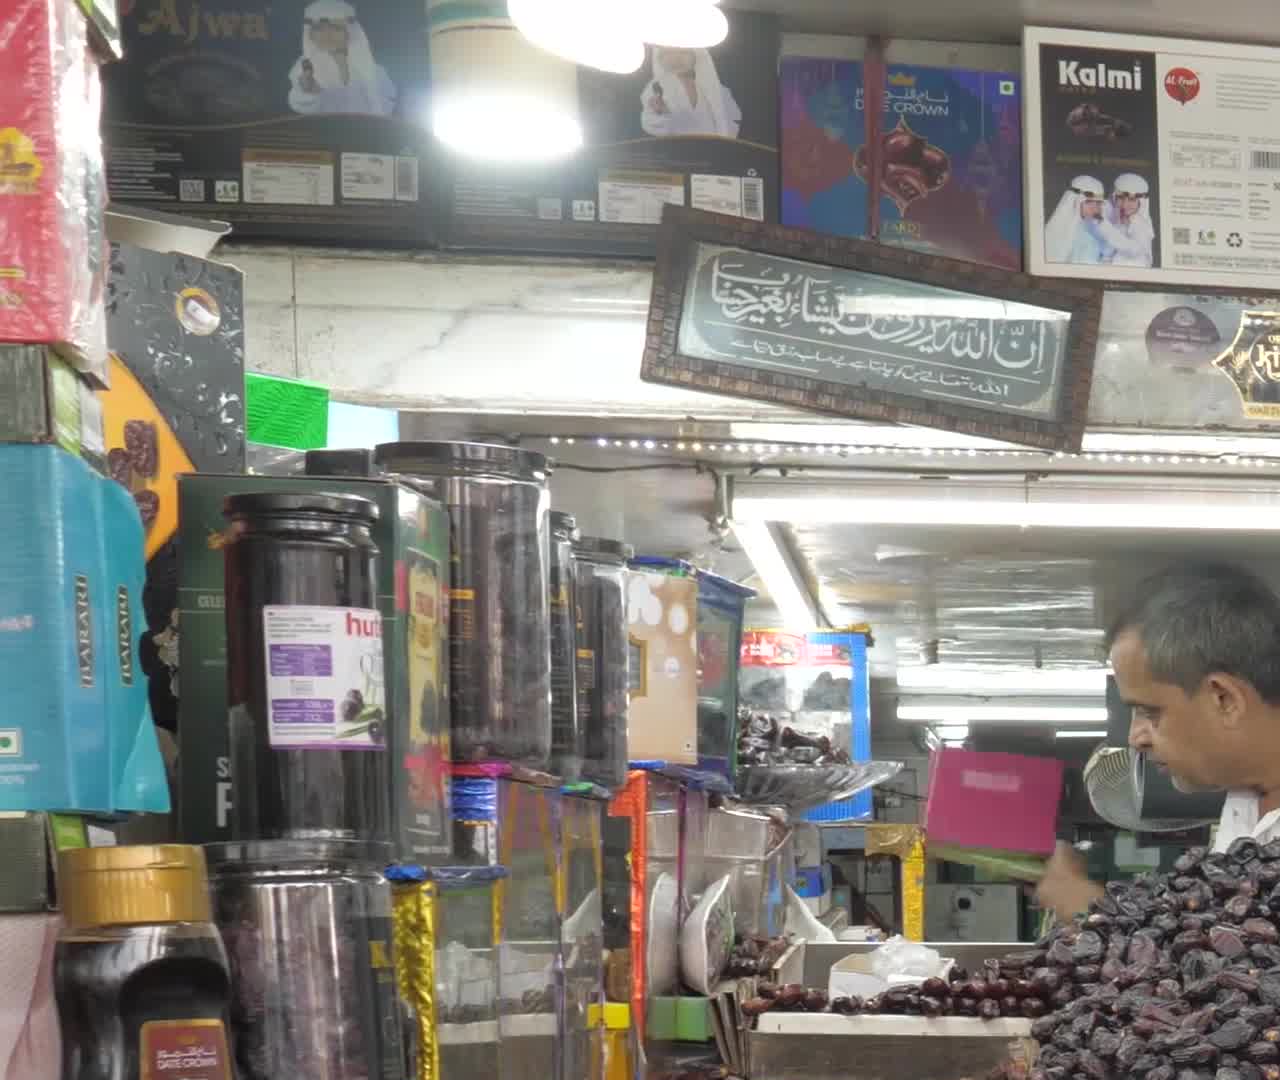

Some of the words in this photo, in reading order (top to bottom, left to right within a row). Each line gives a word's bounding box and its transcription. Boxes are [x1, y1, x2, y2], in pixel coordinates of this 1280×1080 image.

[1058, 60, 1142, 91] Kalmi
[855, 99, 889, 112] DE
[893, 102, 949, 117] CROWN
